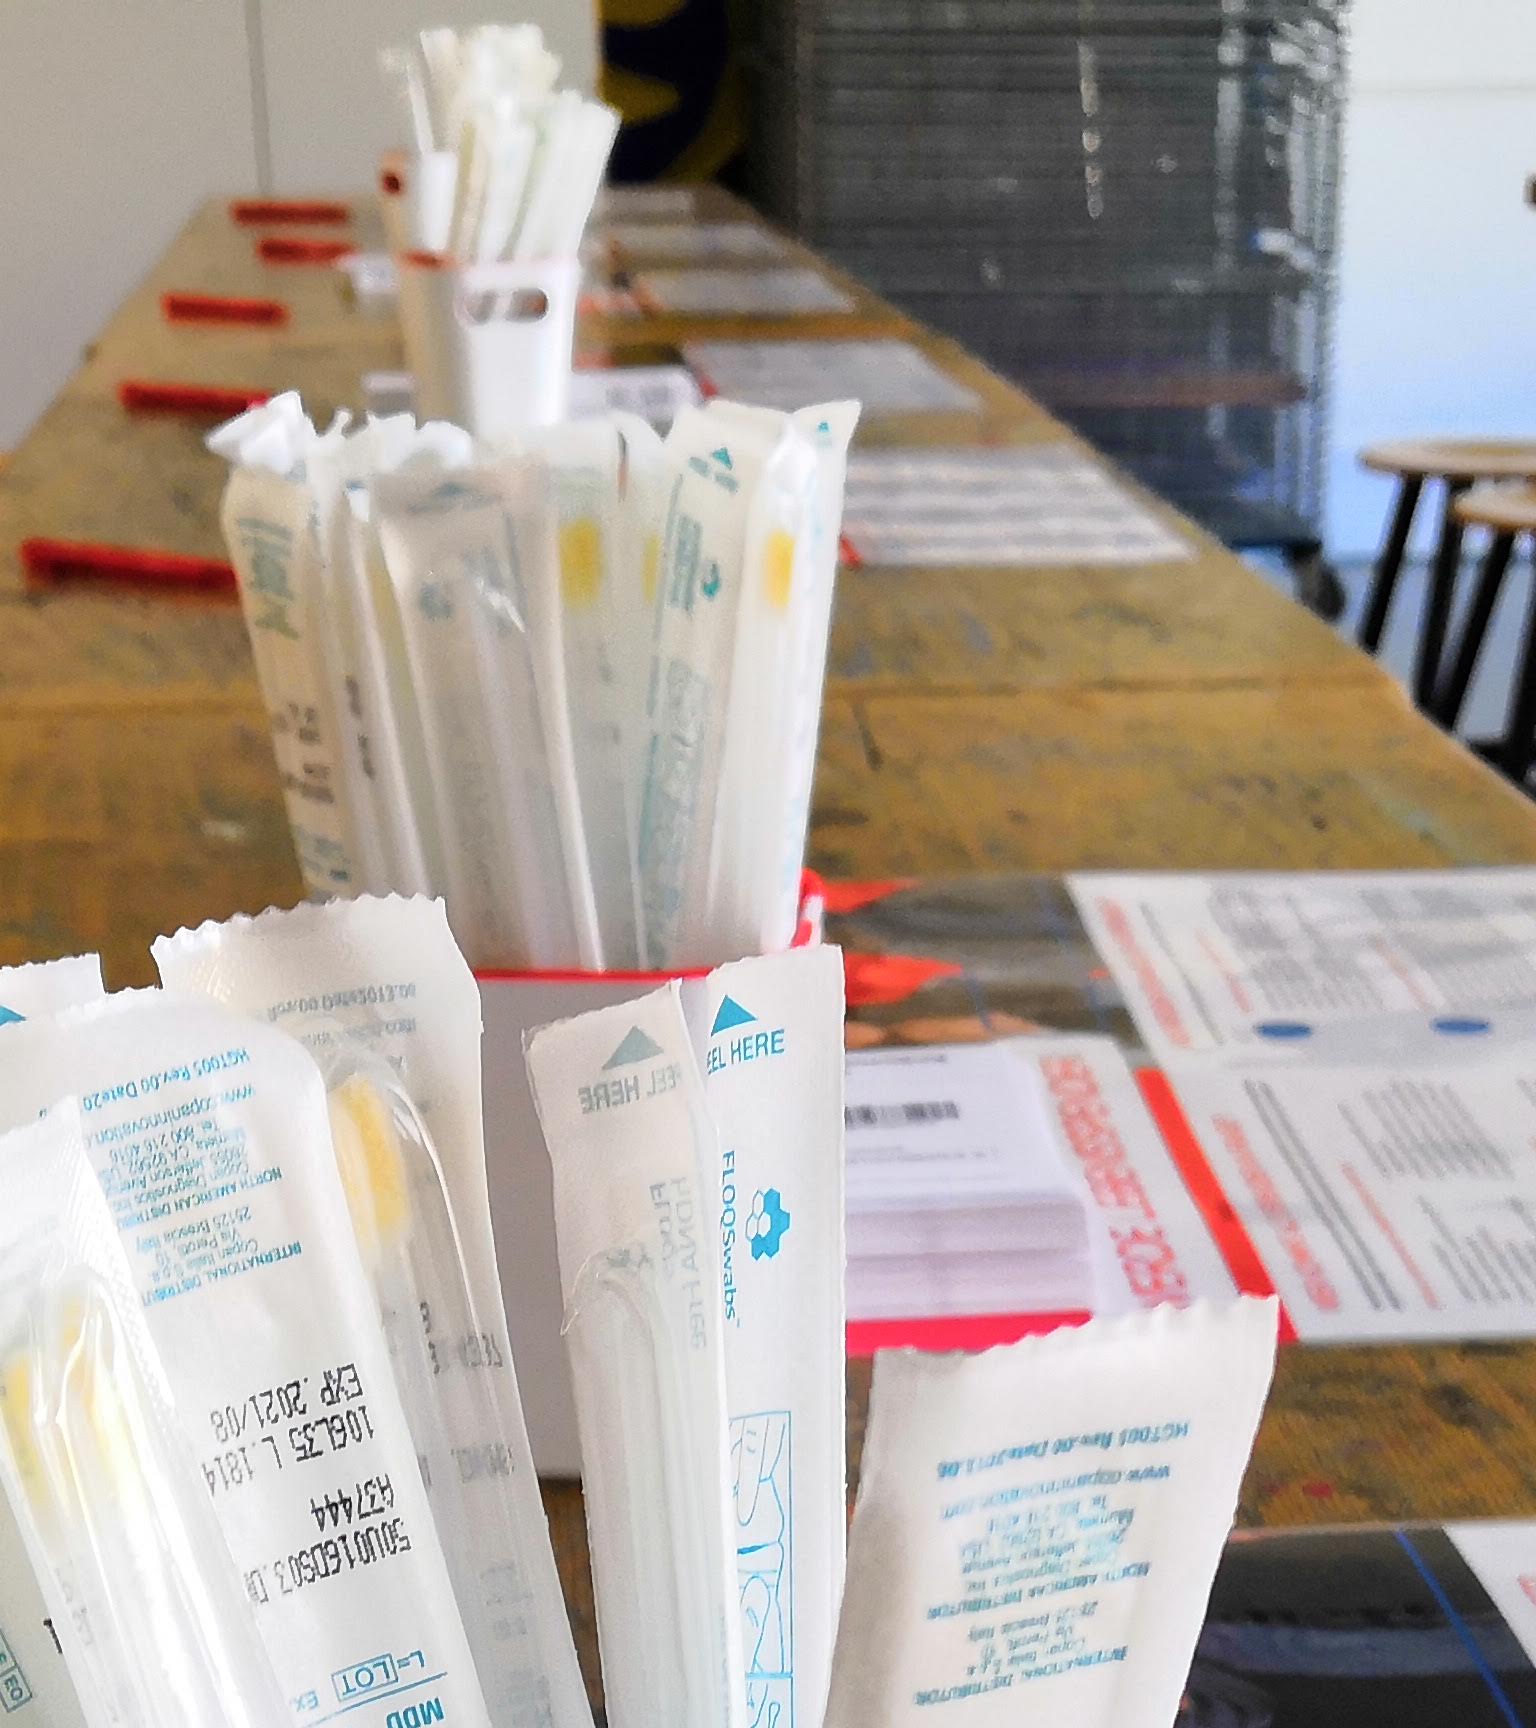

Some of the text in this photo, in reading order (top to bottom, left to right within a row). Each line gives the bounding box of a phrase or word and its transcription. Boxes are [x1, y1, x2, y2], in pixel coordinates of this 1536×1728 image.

[731, 1029, 784, 1064] HERE
[207, 1241, 301, 1279] INTERNATIONAL
[211, 1364, 363, 1442] EXP.2021/08
[289, 1406, 373, 1462] 106L35
[311, 1474, 394, 1532] A37444
[4, 1675, 23, 1701] EO
[334, 1660, 393, 1696] LOT
